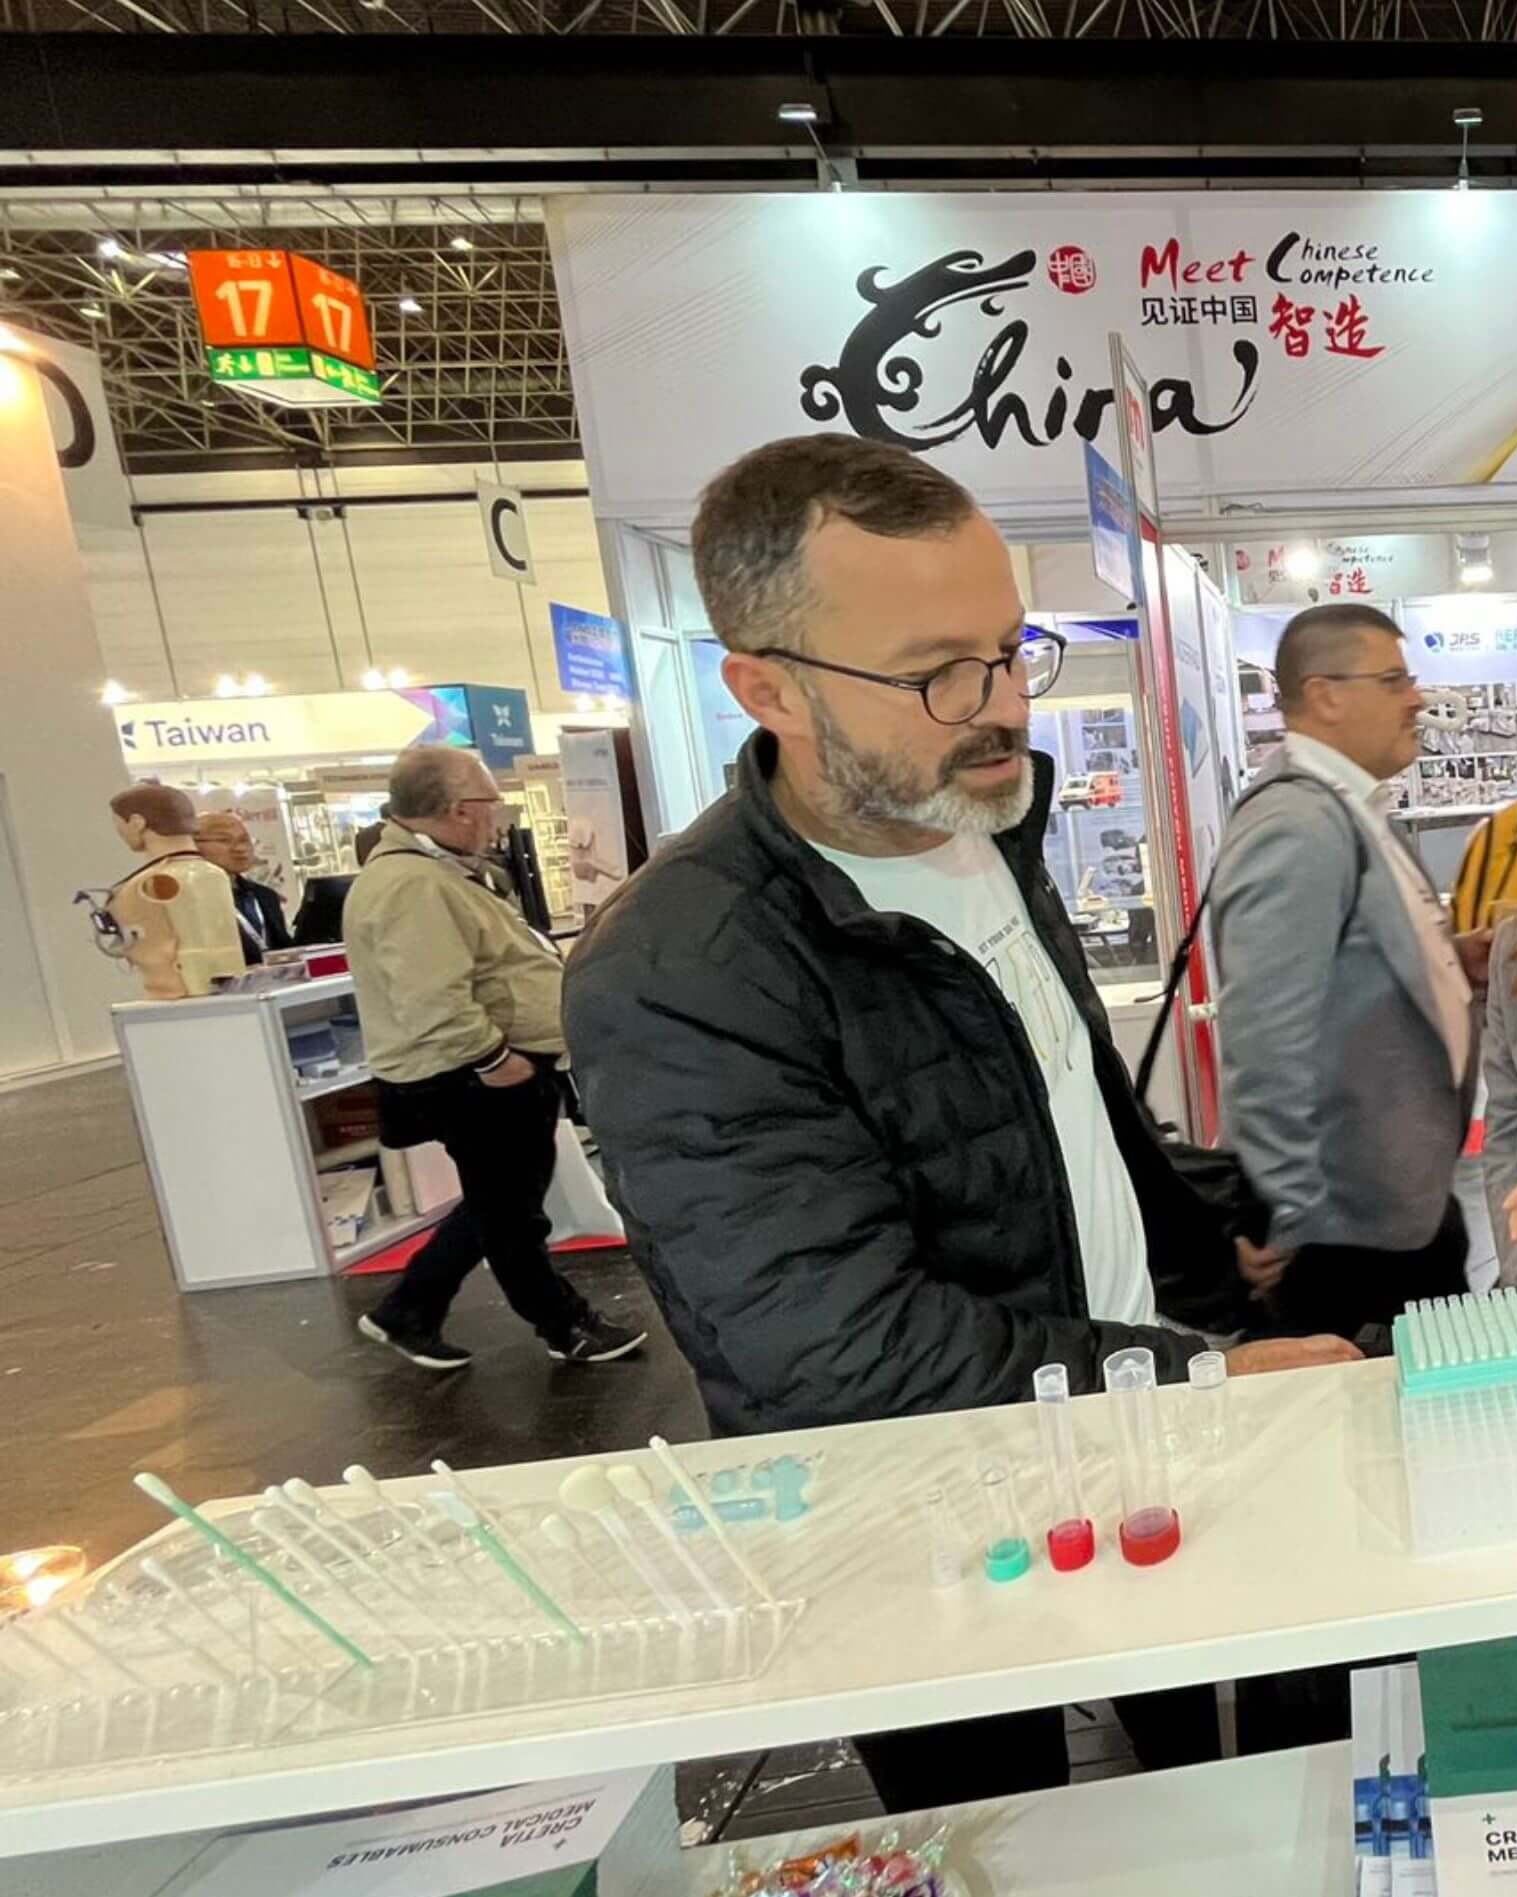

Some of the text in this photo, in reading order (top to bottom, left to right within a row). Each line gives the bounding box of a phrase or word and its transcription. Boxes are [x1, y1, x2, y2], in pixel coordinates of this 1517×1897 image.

[1141, 238, 1254, 292] Meet
[216, 280, 272, 337] 17
[311, 293, 353, 352] 17
[1141, 292, 1386, 358] 见证中国 智造
[491, 498, 527, 571] C
[144, 717, 270, 747] Taiwan
[499, 1816, 584, 1849] CRETIA
[502, 1798, 597, 1834] MEDICAL
[326, 1825, 497, 1870] CONSUMABLES
